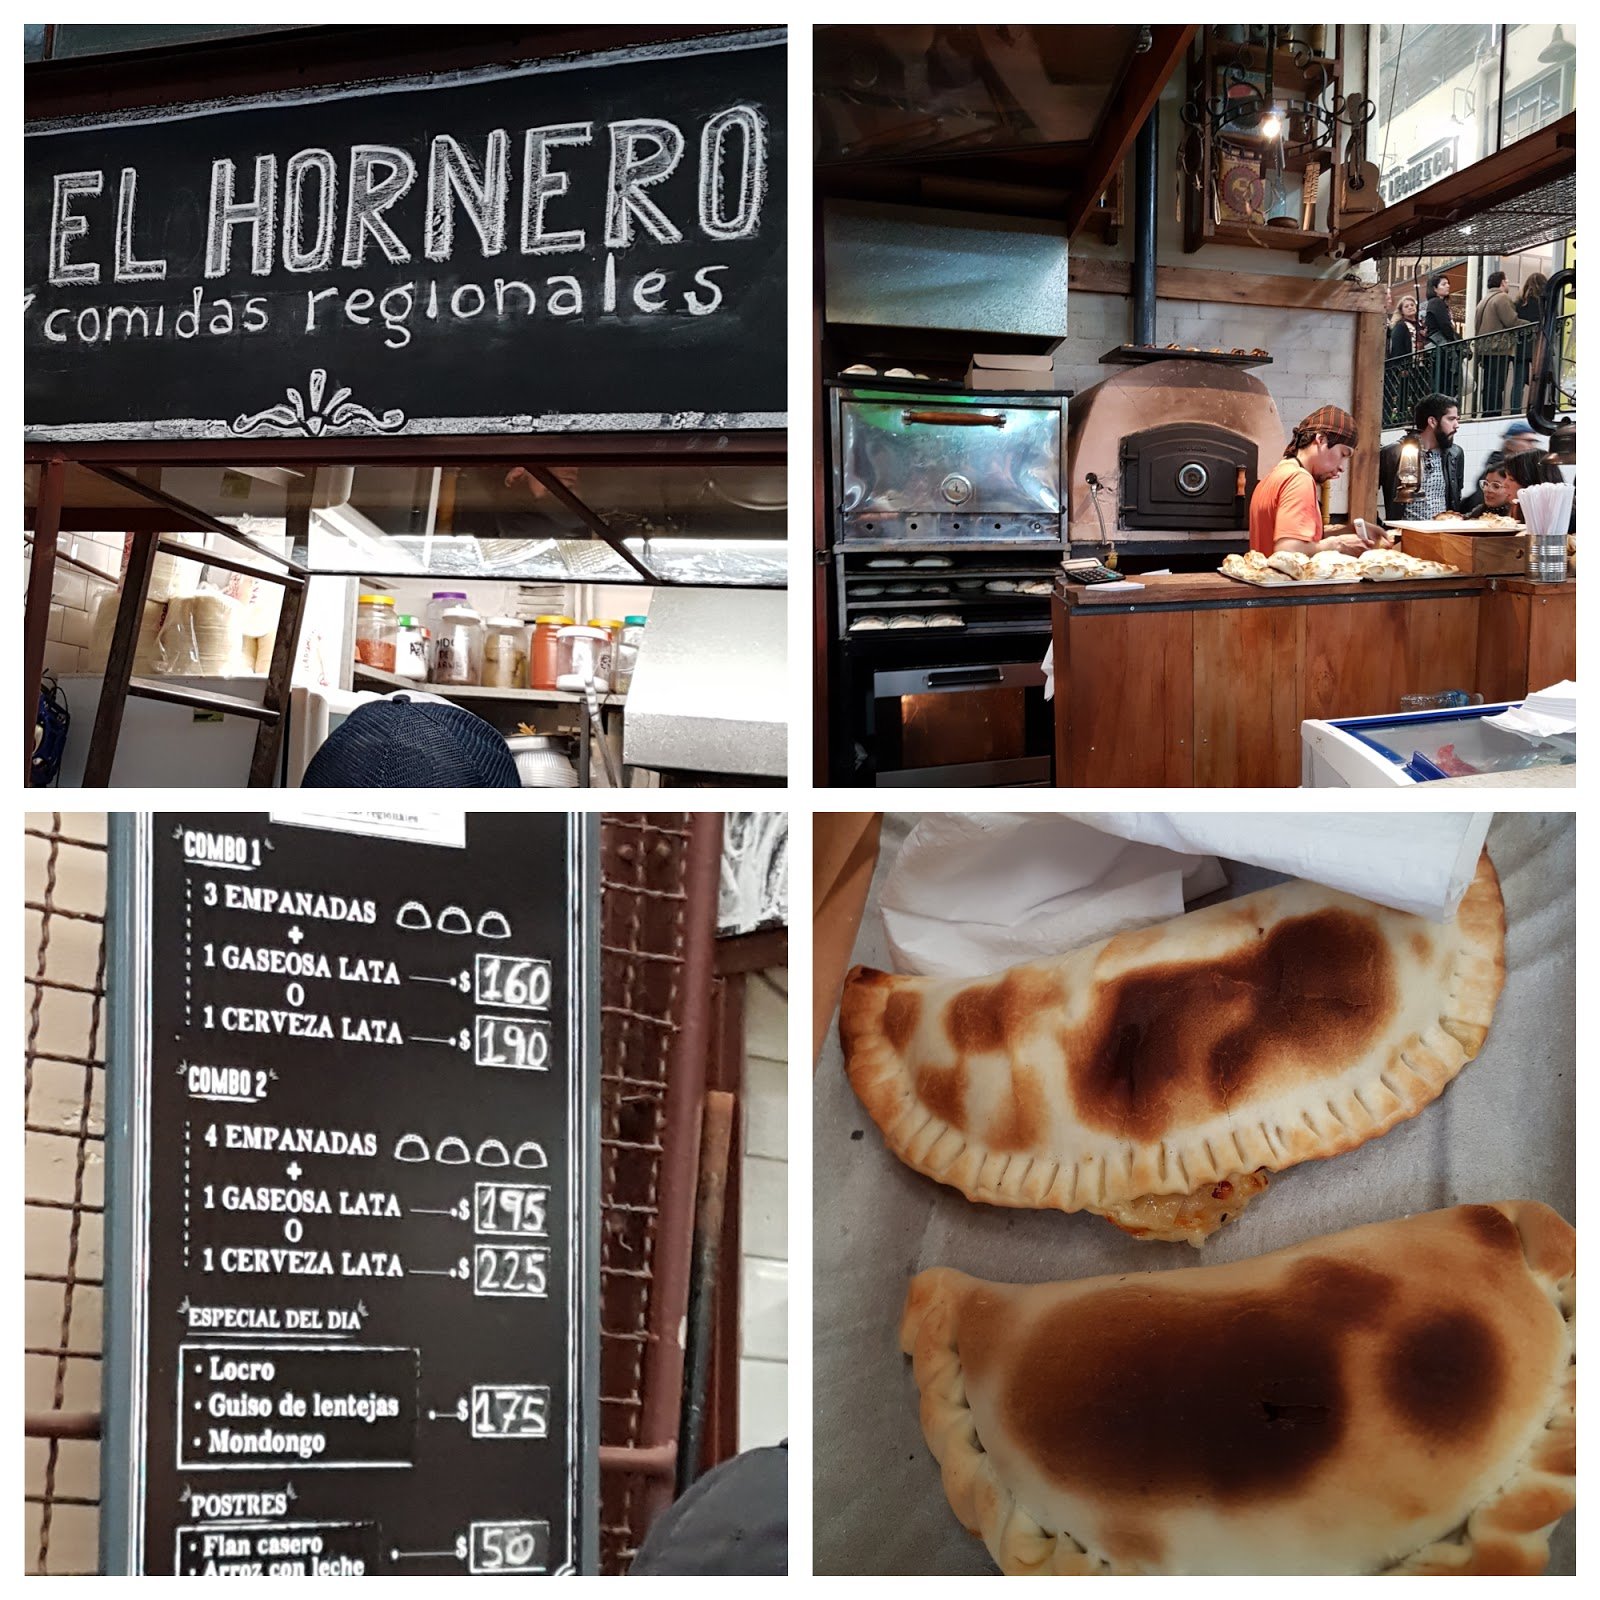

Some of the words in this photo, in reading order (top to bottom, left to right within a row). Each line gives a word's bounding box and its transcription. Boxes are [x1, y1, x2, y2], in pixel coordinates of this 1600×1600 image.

[49, 168, 167, 285] EL
[204, 105, 768, 279] HORNERO
[44, 286, 269, 343] comidas
[305, 253, 730, 348] regionales
[184, 831, 246, 863] COMBO
[250, 839, 261, 866] 1
[204, 882, 217, 906] 3
[225, 884, 376, 923] EMPANADAS
[204, 944, 215, 966] 1
[222, 945, 331, 978] GASEOSA
[339, 958, 400, 985] LATA
[459, 970, 471, 993] $
[480, 959, 549, 1005] 160
[286, 983, 304, 1006] O
[204, 1005, 214, 1029] 1
[221, 1007, 334, 1038] CERVEZA
[341, 1018, 403, 1044] LATA
[459, 1028, 471, 1051] $
[481, 1022, 548, 1064] 190
[188, 1066, 250, 1096] COMBO
[255, 1070, 267, 1097] 2
[205, 1124, 217, 1148] 4
[225, 1124, 377, 1156] EMPANADAS
[204, 1185, 214, 1208] 1
[222, 1186, 332, 1213] GASEOSA
[339, 1191, 401, 1217] LATA
[459, 1199, 470, 1221] $
[481, 1188, 546, 1230] 195
[284, 1218, 303, 1242] O
[203, 1248, 214, 1271] 1
[221, 1248, 334, 1274] CERVEZA
[341, 1252, 403, 1277] LATA
[458, 1257, 470, 1280] $
[479, 1253, 546, 1291] 225
[188, 1308, 281, 1329] ESPECIAL
[285, 1309, 323, 1329] DEL
[327, 1309, 361, 1330] DIA
[210, 1356, 275, 1381] Locro
[208, 1392, 272, 1417] Guiso
[279, 1393, 306, 1417] de
[313, 1393, 399, 1423] lentejas
[457, 1398, 469, 1421] $
[474, 1392, 545, 1433] 175
[208, 1428, 326, 1458] Mondongo
[190, 1493, 287, 1517] POSTRES
[203, 1535, 251, 1556] Flan
[257, 1537, 323, 1555] casero
[456, 1536, 467, 1559] $
[204, 1560, 262, 1576] Arroz
[269, 1561, 305, 1576] con
[312, 1556, 365, 1576] leche
